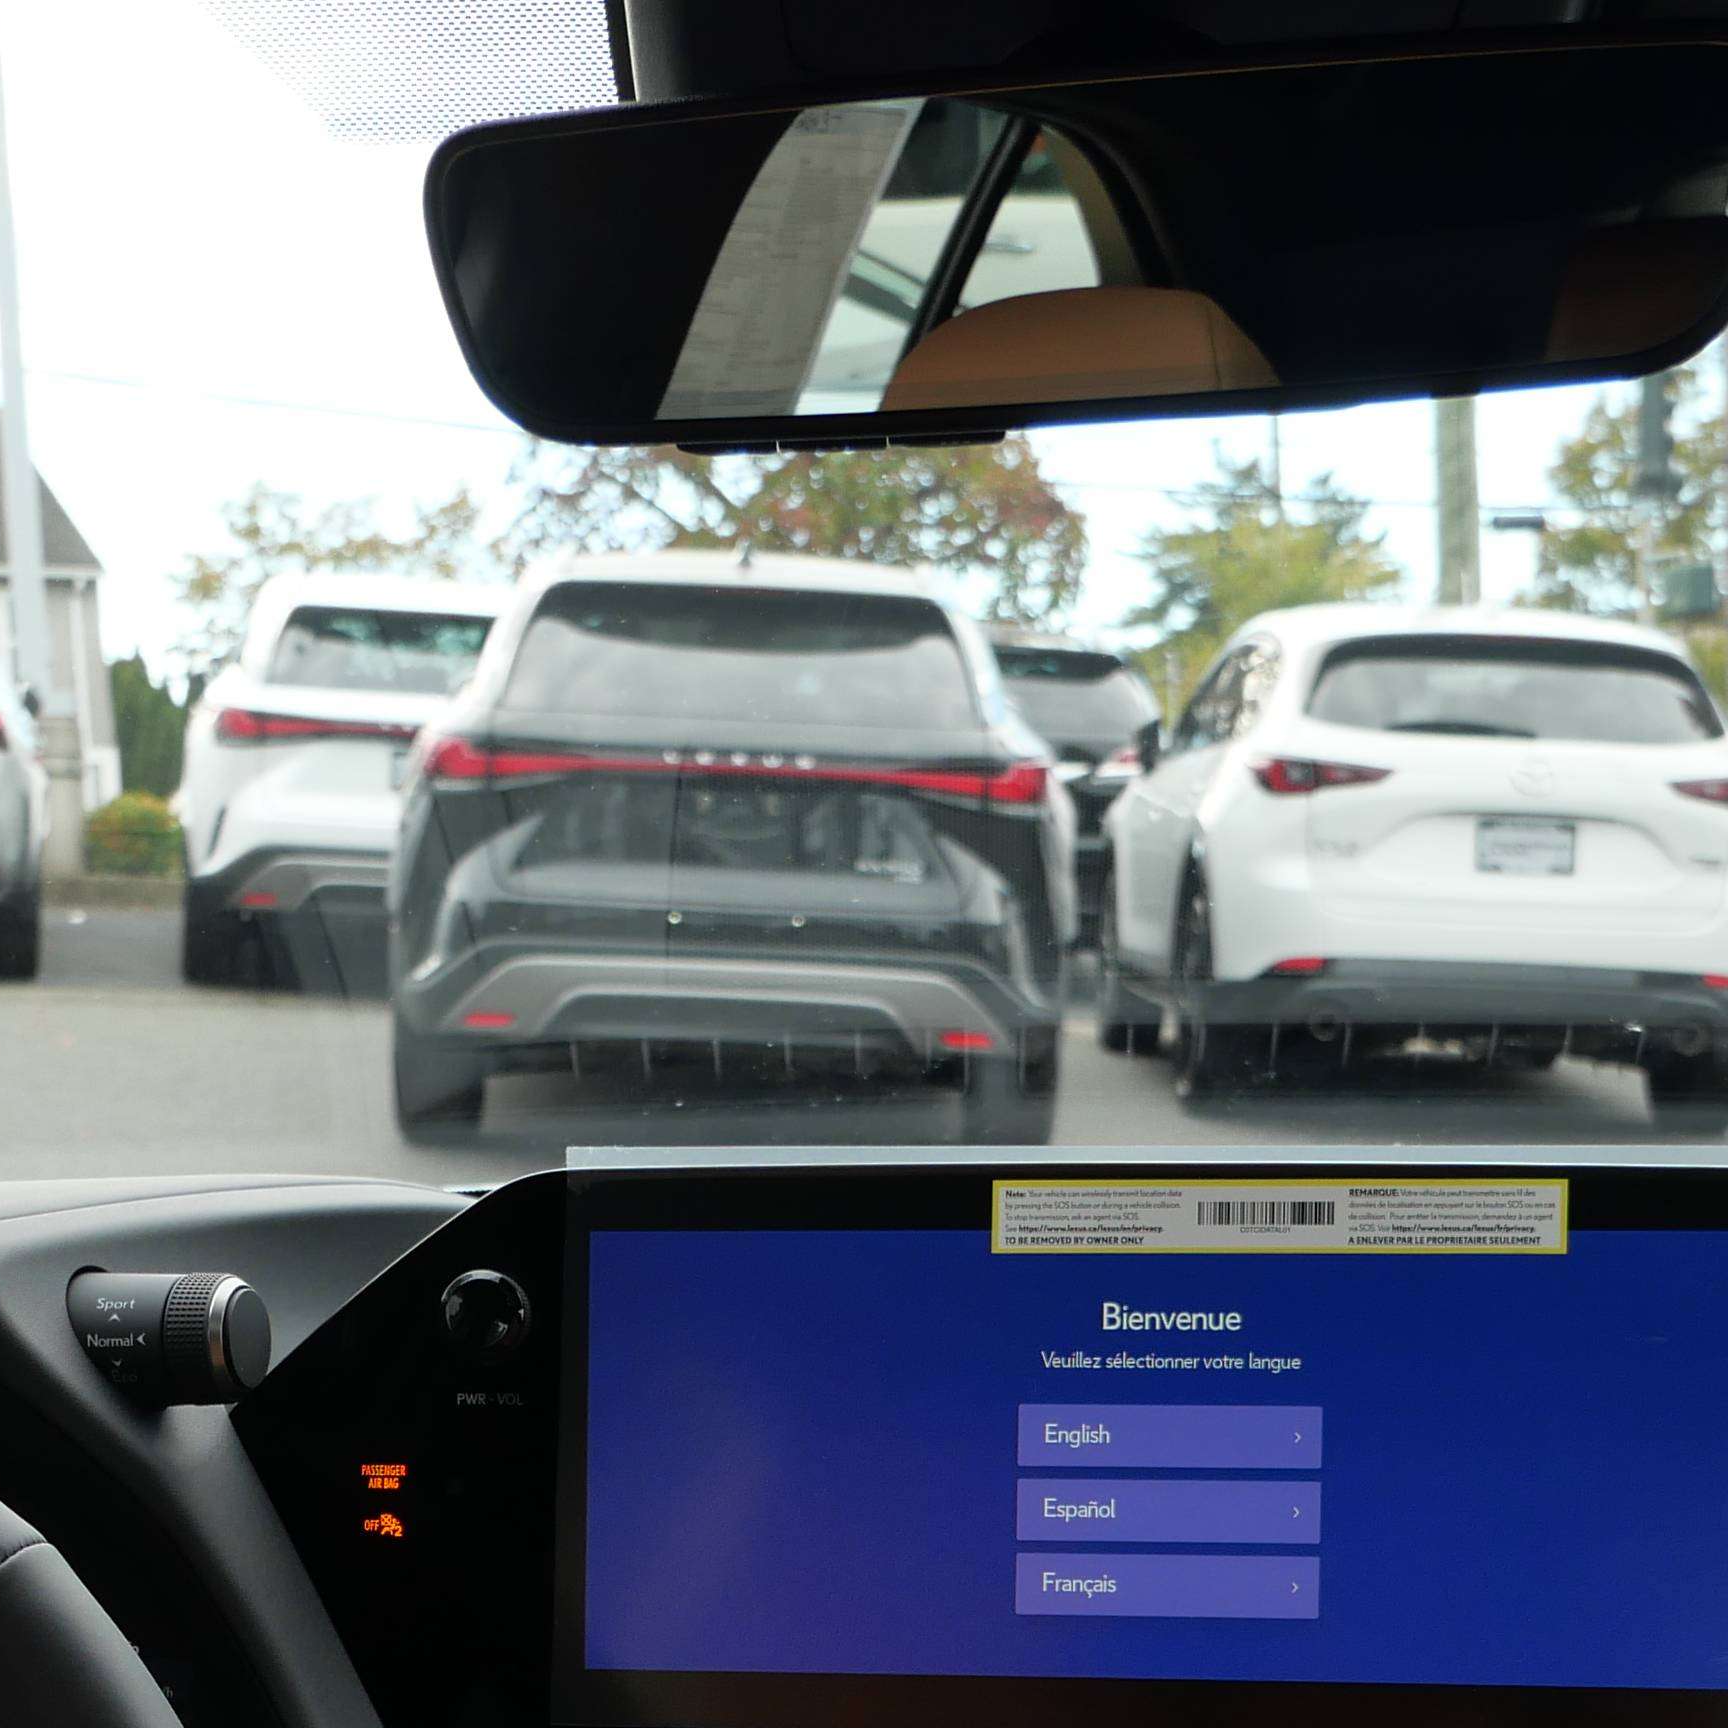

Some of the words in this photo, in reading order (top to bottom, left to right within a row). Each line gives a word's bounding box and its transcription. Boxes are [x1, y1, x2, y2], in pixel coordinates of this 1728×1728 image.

[1005, 1190, 1025, 1198] Note:
[1349, 1189, 1399, 1197] REMARQUE:
[1030, 1237, 1071, 1245] REMOVED
[1086, 1237, 1119, 1245] OWNER
[1120, 1237, 1144, 1245] ONLY
[1356, 1236, 1394, 1246] ENLEVER
[1396, 1236, 1413, 1246] PAR
[1426, 1236, 1488, 1246] PROPRIETAIRE
[1489, 1236, 1541, 1246] SEULEMENT
[96, 1297, 136, 1312] Sport
[1102, 1301, 1242, 1332] Bienvenue
[86, 1333, 134, 1348] Normal
[1041, 1351, 1101, 1370] Veuillez
[1105, 1351, 1200, 1371] sélectionner
[1204, 1355, 1244, 1371] votre
[1249, 1352, 1302, 1374] langue
[456, 1393, 486, 1405] PWR
[497, 1393, 528, 1406] VOL
[1045, 1423, 1111, 1448] English
[360, 1464, 407, 1477] PASSENGER
[368, 1478, 383, 1490] AIR
[384, 1478, 400, 1490] BAG
[1043, 1498, 1116, 1523] Español
[364, 1519, 379, 1532] OFF
[1042, 1572, 1117, 1598] Français
